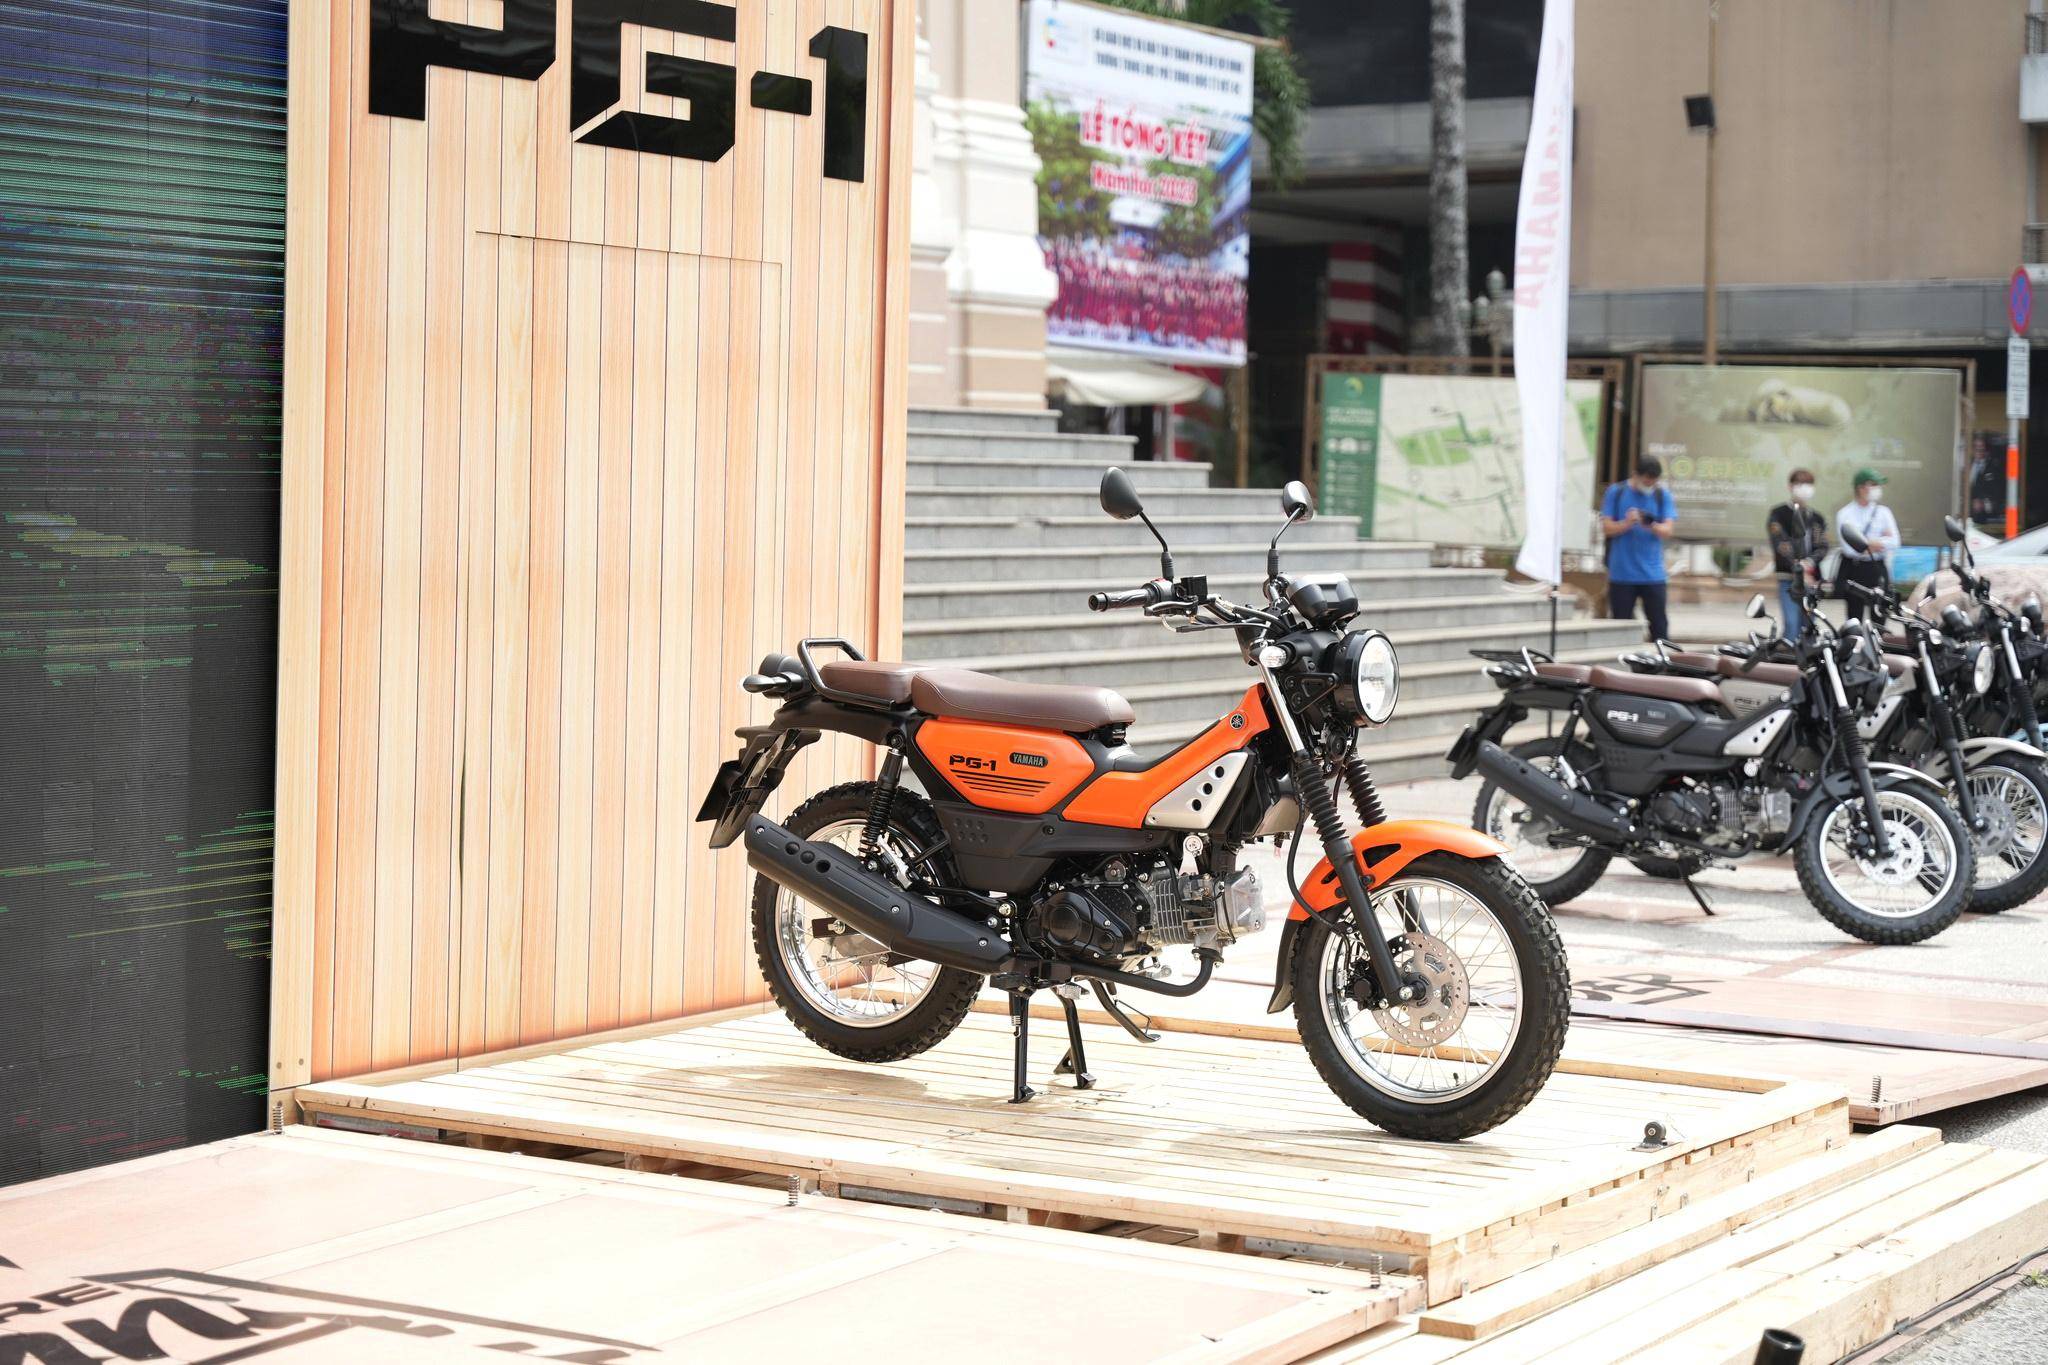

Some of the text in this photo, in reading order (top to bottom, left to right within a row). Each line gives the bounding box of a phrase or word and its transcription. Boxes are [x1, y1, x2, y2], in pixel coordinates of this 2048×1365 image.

[368, 0, 868, 183] PG-1
[949, 754, 1044, 771] PG-1 YAMAHA
